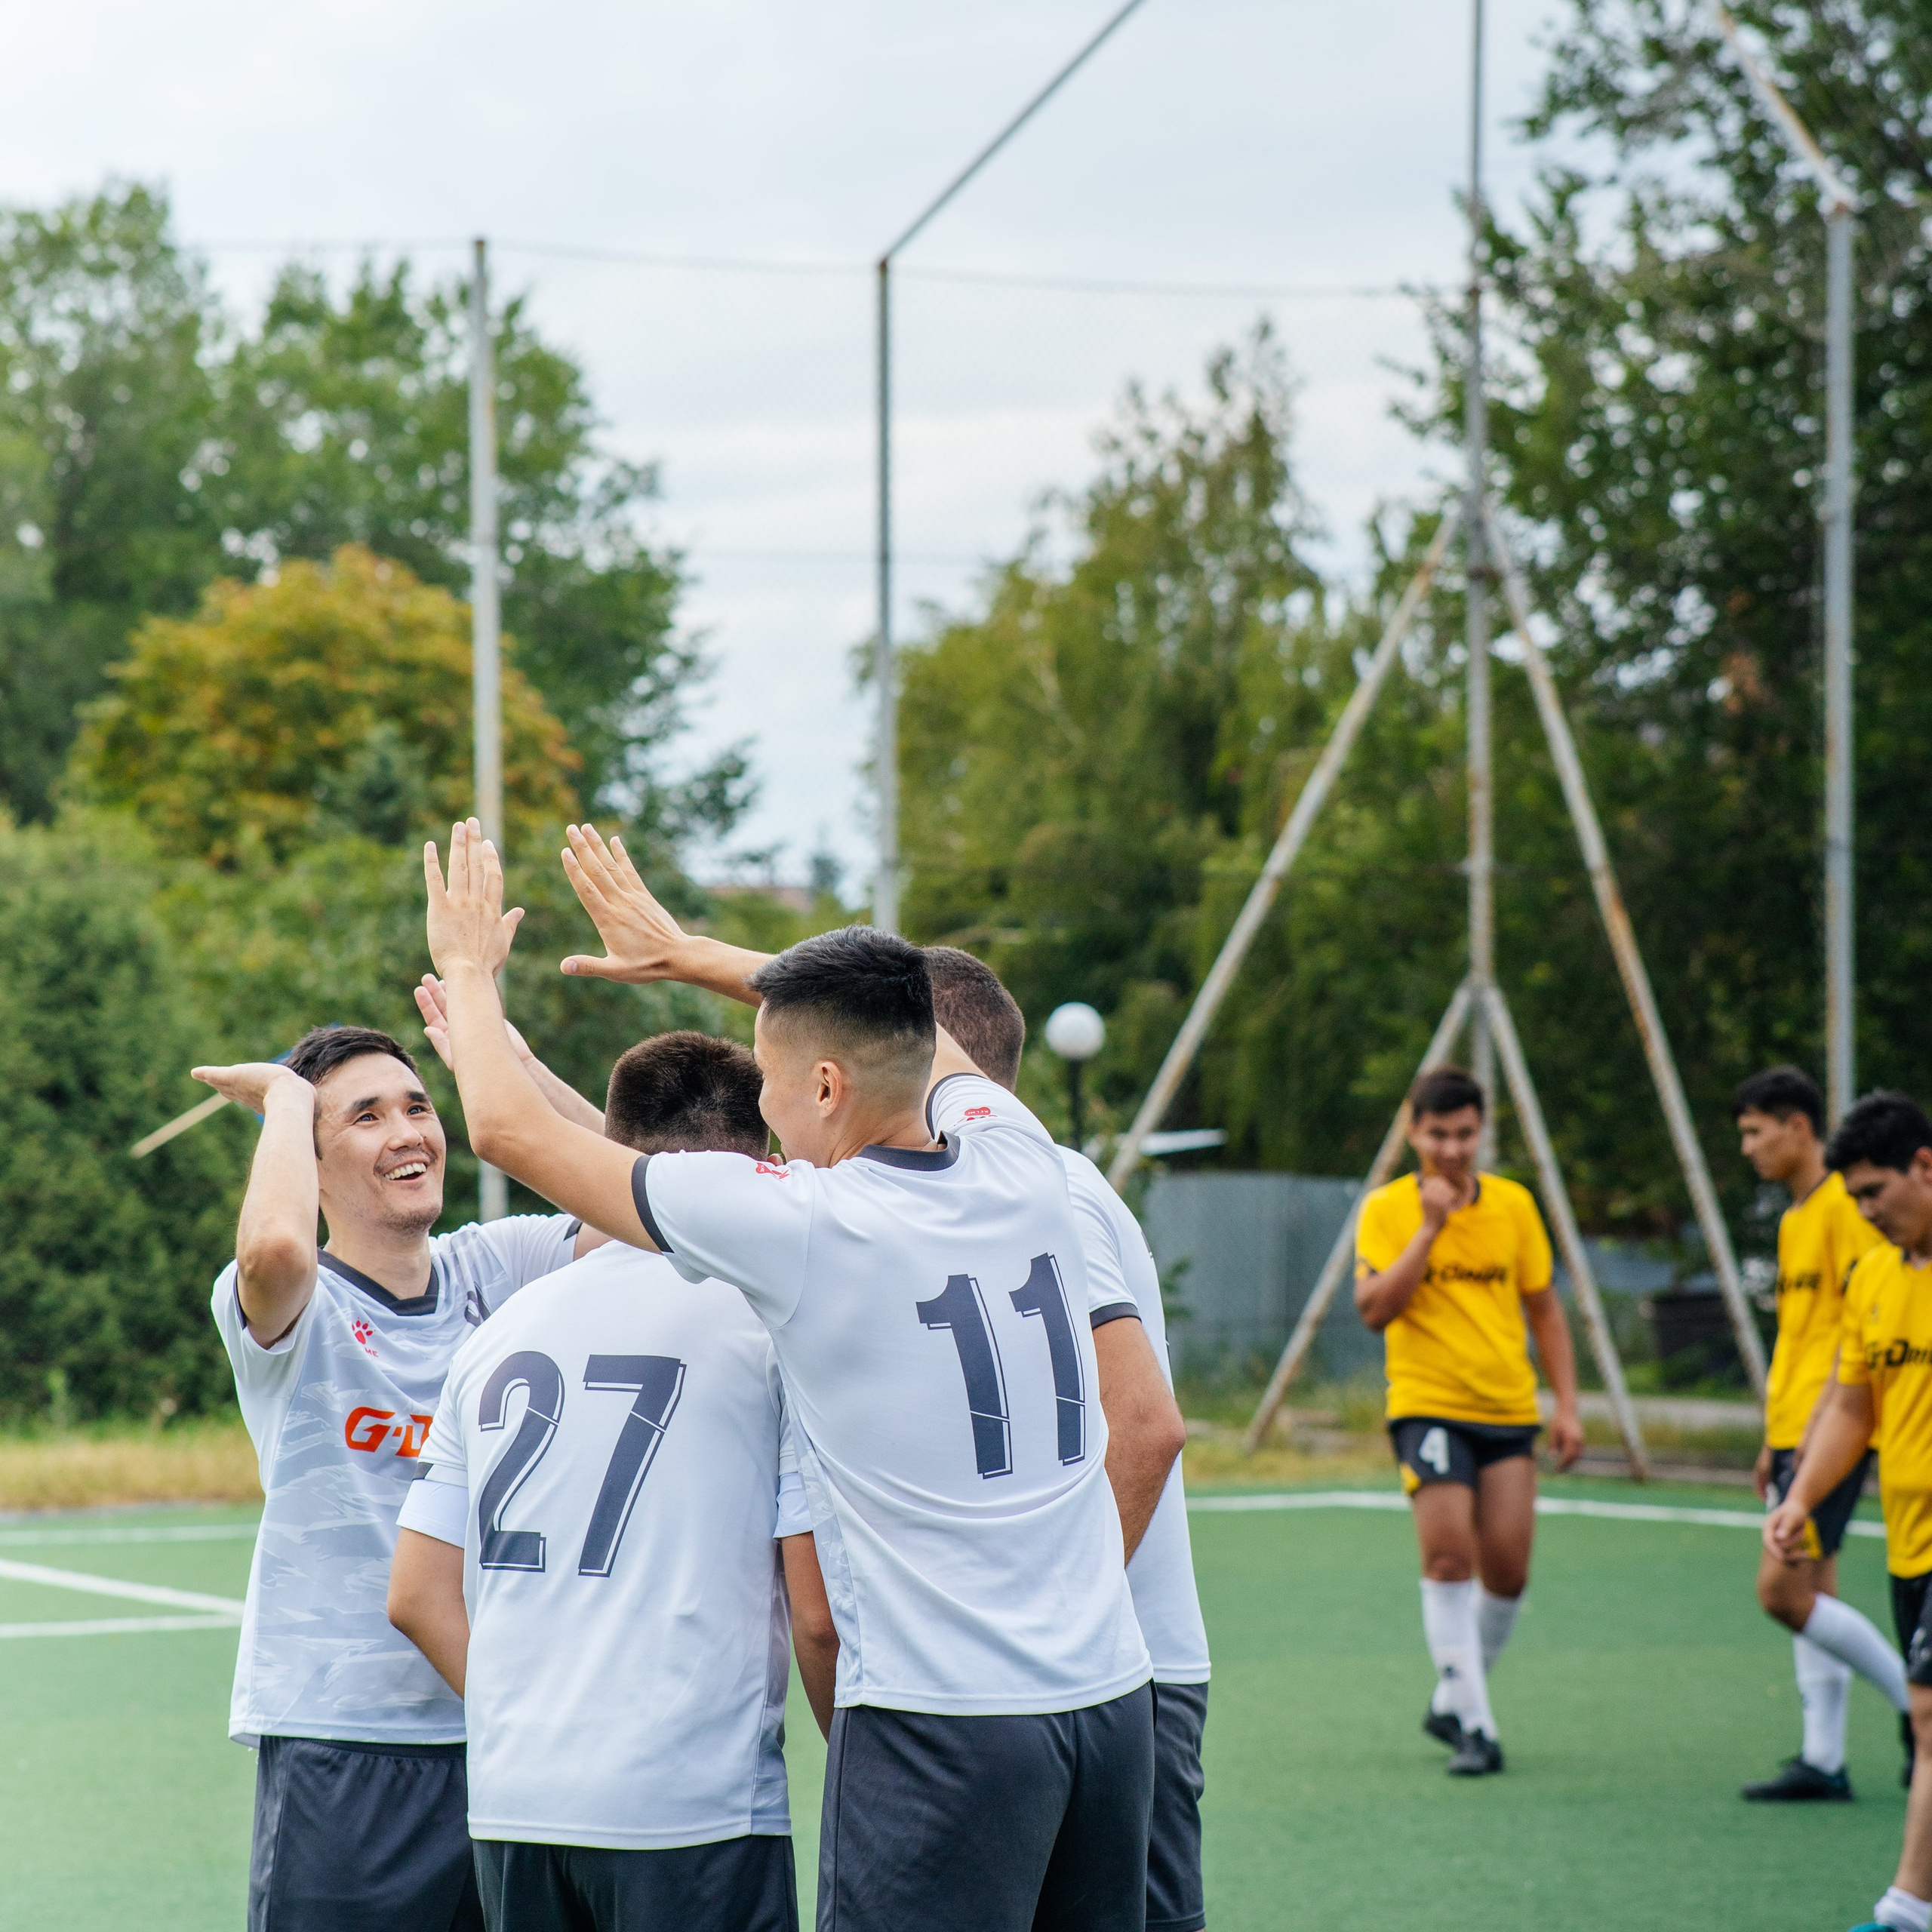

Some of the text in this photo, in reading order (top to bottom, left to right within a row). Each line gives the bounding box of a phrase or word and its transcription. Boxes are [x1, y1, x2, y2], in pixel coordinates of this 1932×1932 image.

[478, 1350, 687, 1578] 27
[915, 1252, 1086, 1480] 11
[1419, 1426, 1450, 1474] 4
